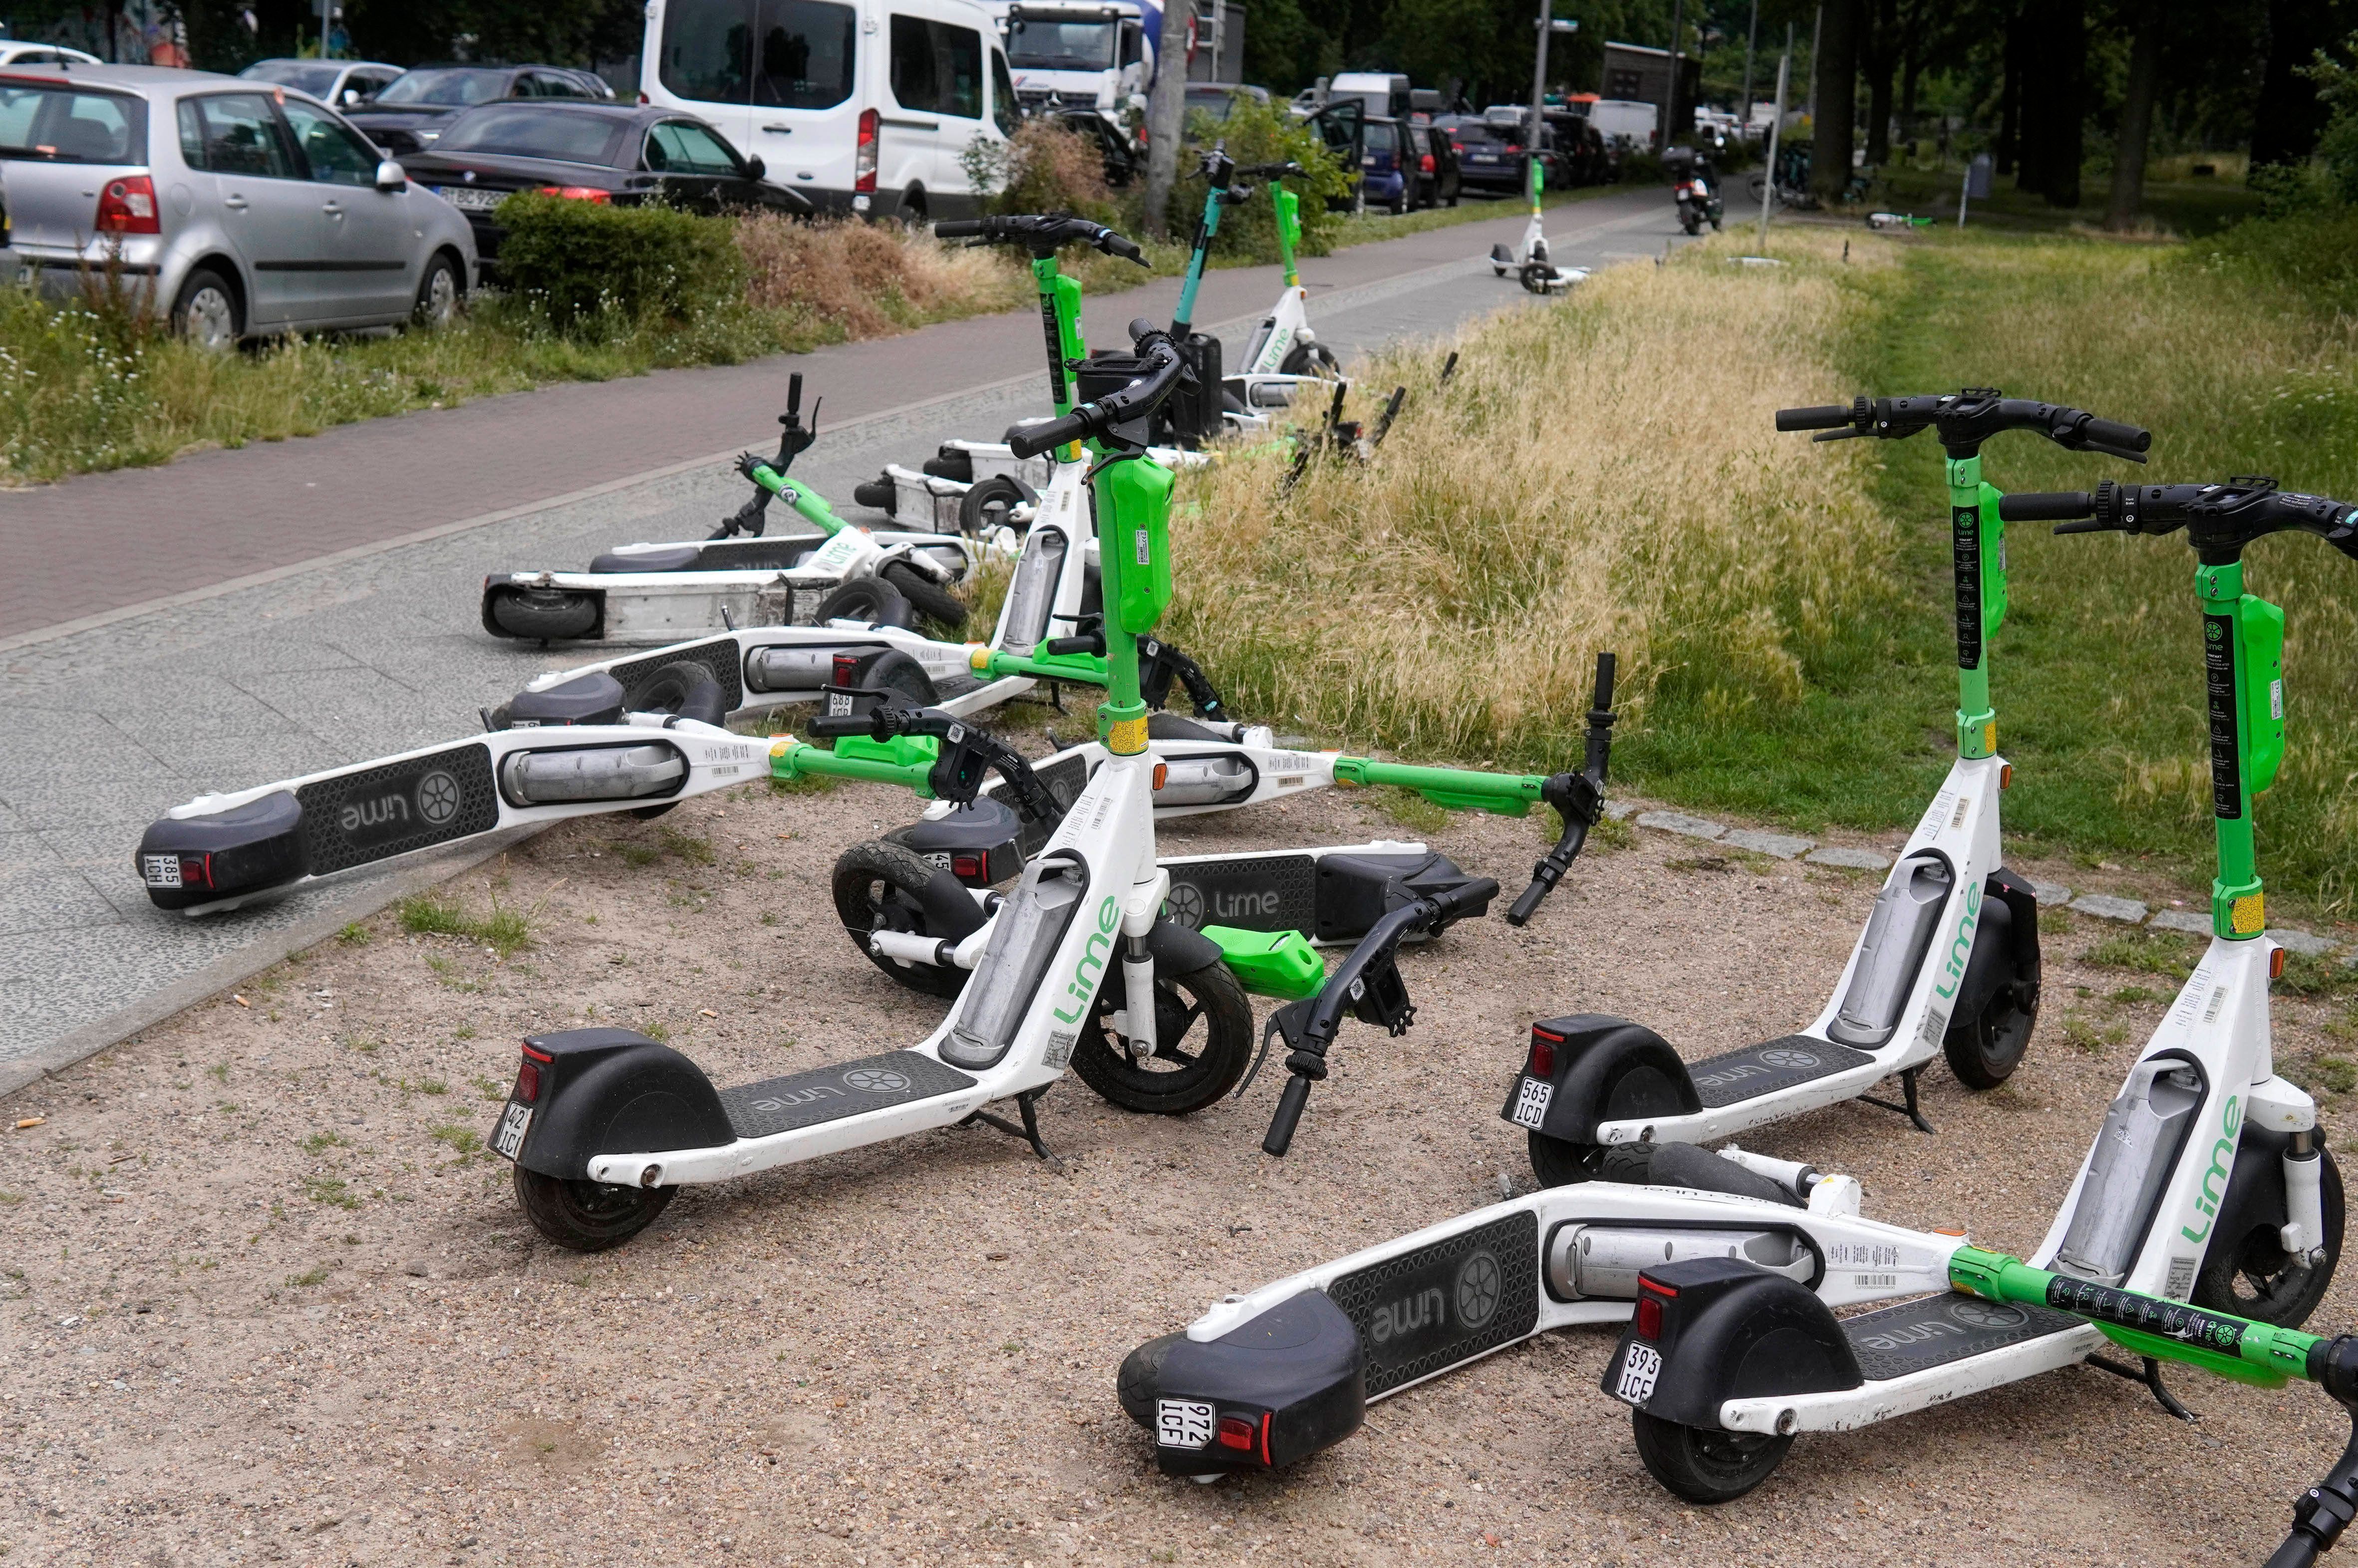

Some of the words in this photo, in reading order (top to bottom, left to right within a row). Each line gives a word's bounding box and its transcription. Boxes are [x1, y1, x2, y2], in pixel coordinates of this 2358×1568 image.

[1263, 328, 1289, 367] Lime
[819, 542, 857, 564] Lime
[2206, 641, 2223, 651] Lime
[340, 794, 410, 831] Lime
[145, 857, 163, 885] ICH
[163, 857, 179, 884] 385
[935, 855, 949, 869] 45
[1215, 890, 1279, 918] Lime
[1936, 881, 1981, 1000] Lime
[1053, 895, 1120, 1024] Lime
[1695, 1064, 1775, 1087] Lime
[750, 1085, 846, 1113] Lime
[1521, 1081, 1548, 1104] 565
[1515, 1105, 1542, 1126] ICD
[2180, 1095, 2241, 1244] Lime
[1371, 1288, 1446, 1343] Lime
[1861, 1321, 1965, 1349] Lime
[1628, 1346, 1658, 1374] 393
[1188, 1406, 1209, 1442] 972
